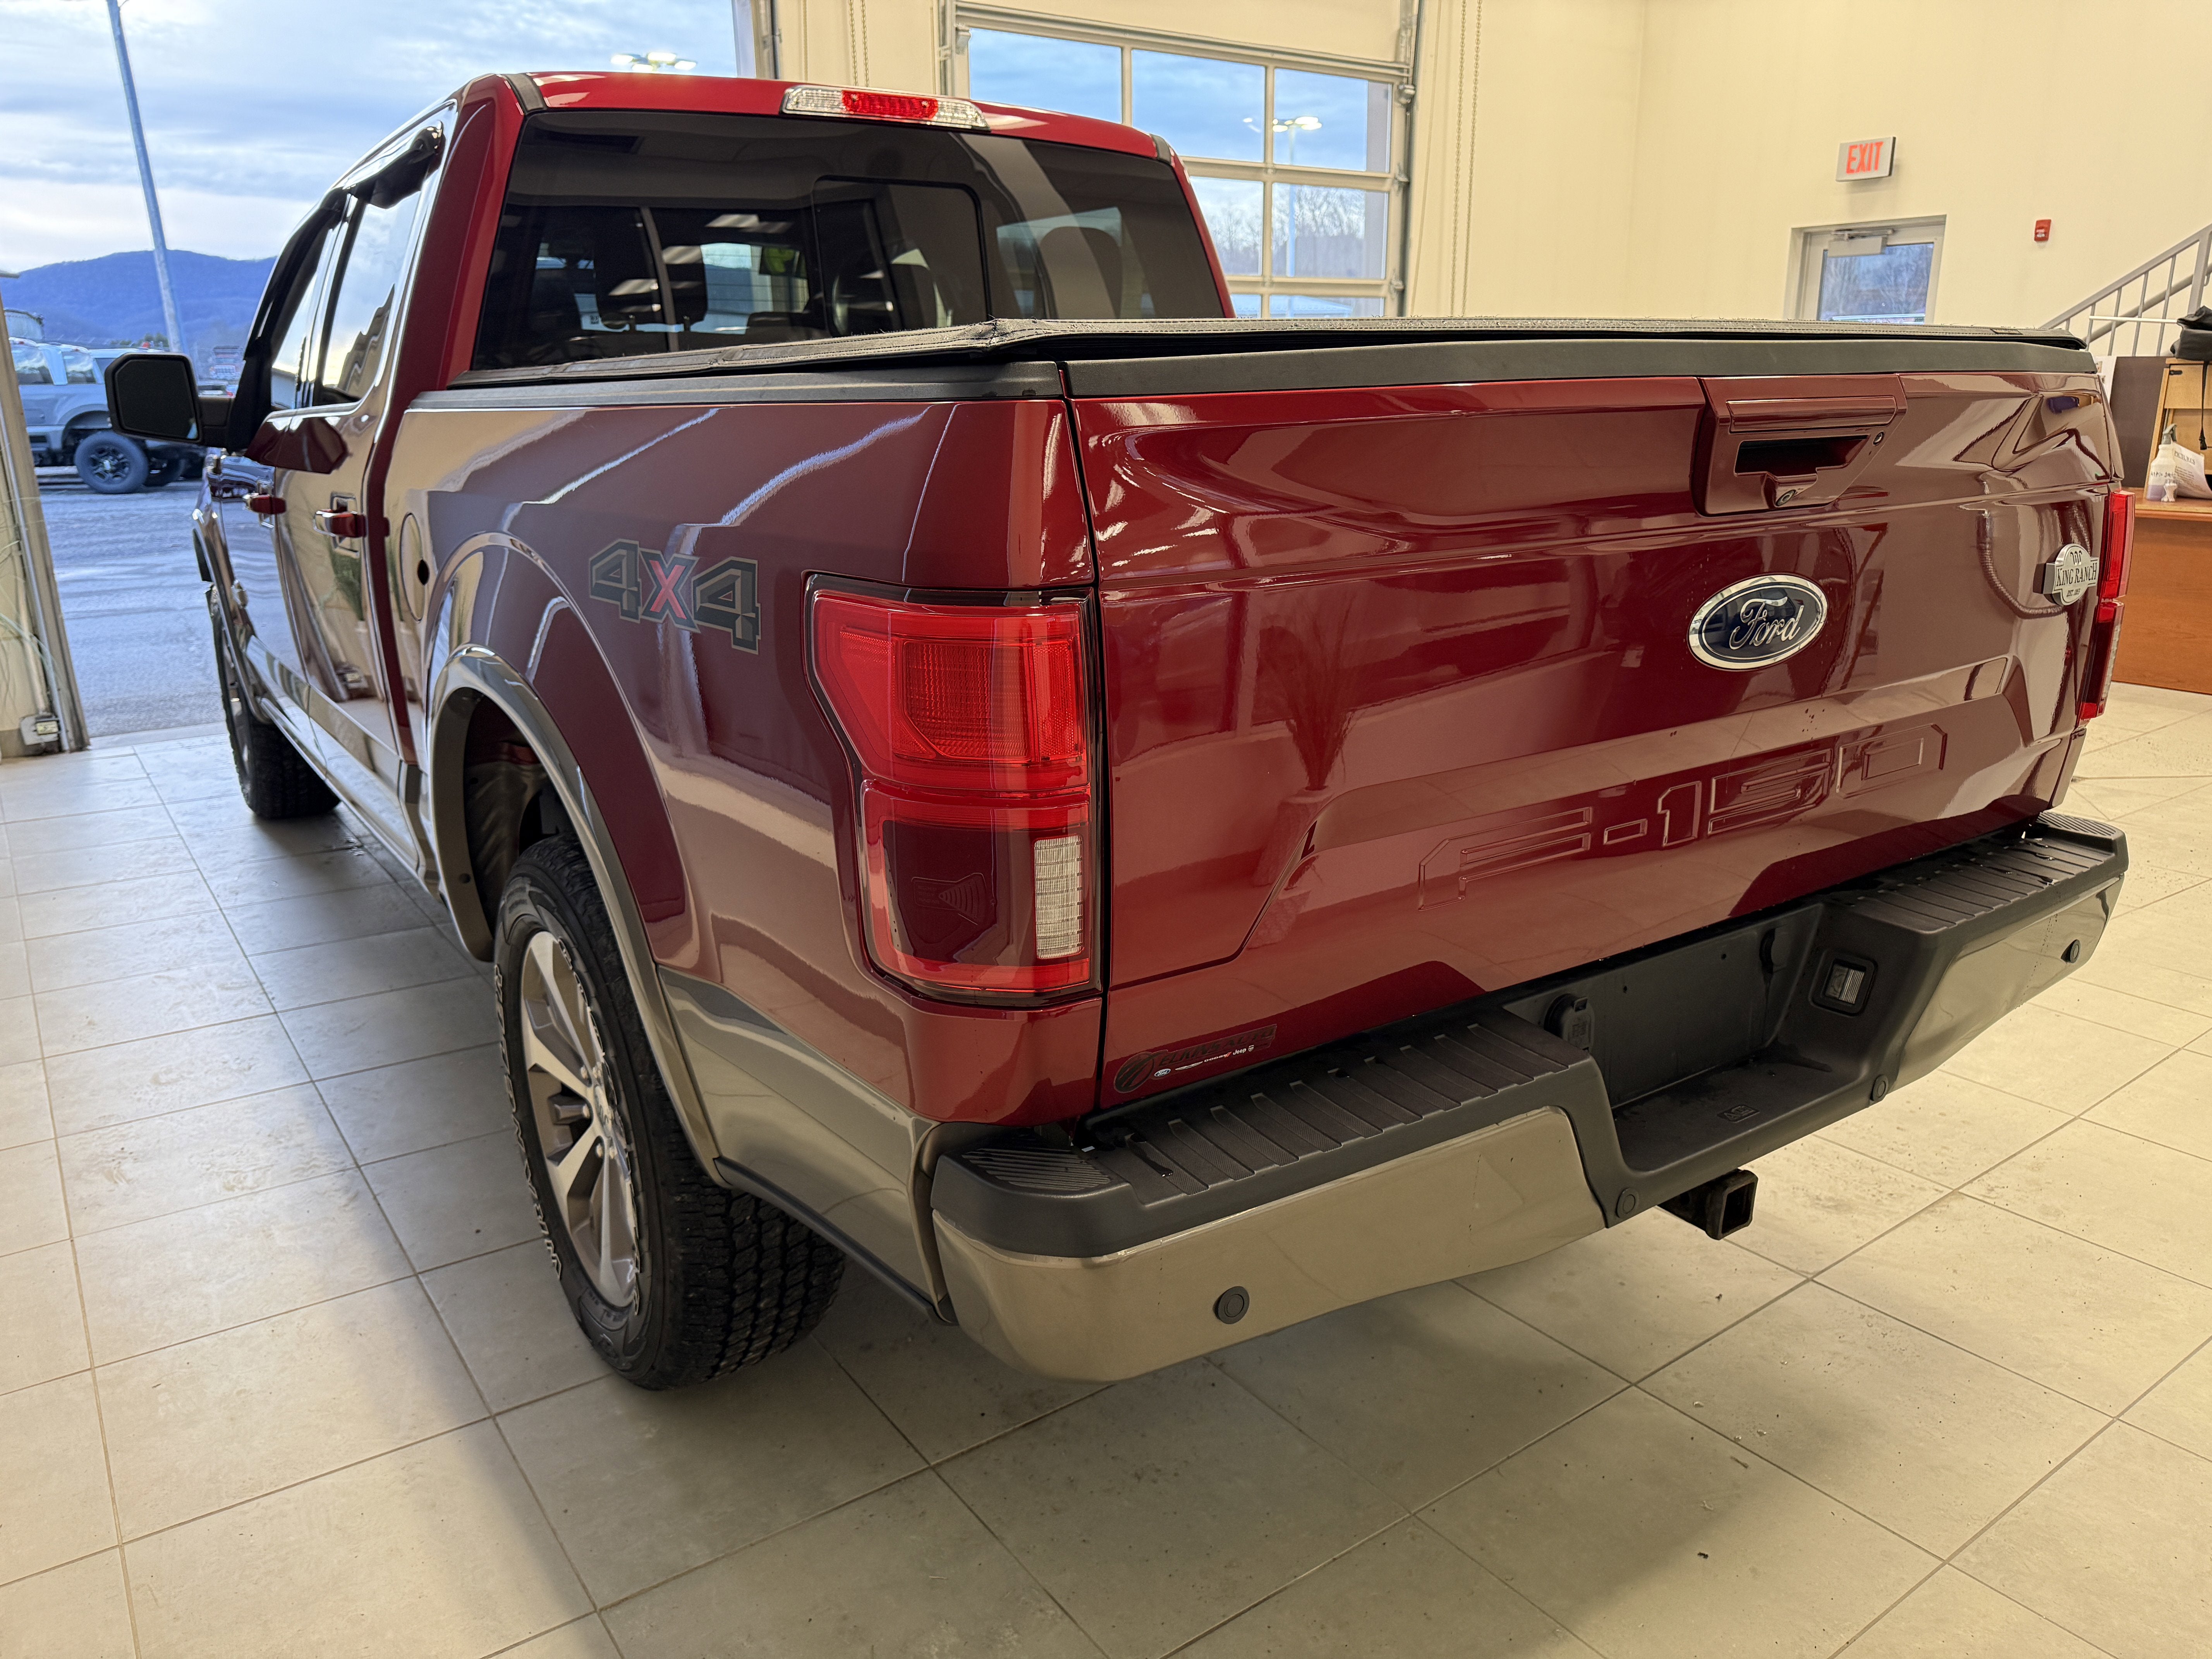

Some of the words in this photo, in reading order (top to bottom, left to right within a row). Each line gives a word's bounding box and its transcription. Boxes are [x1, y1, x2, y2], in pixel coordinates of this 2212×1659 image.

[1846, 141, 1884, 174] EXIT
[2056, 568, 2074, 587] KING
[2074, 563, 2097, 584] RANCH
[1729, 596, 1804, 650] Ford
[1417, 722, 1948, 911] F-150
